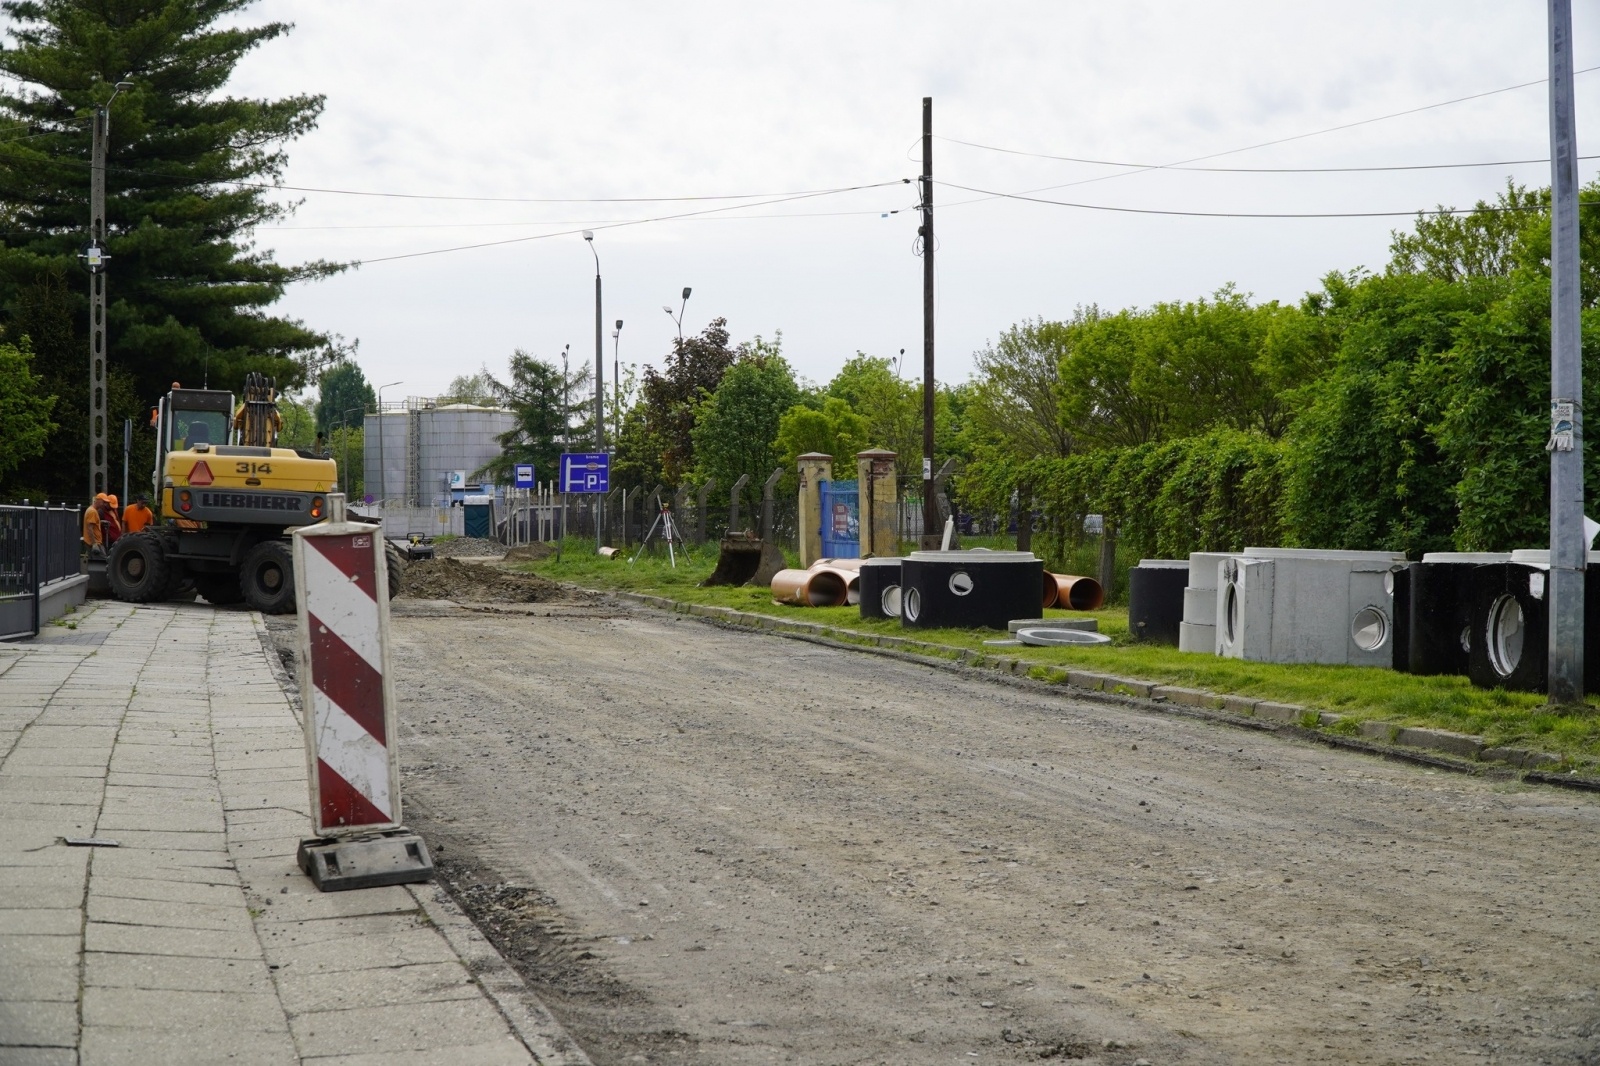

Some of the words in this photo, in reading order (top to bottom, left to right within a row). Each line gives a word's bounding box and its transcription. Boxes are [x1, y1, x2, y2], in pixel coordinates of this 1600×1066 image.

[236, 462, 272, 474] 314
[588, 475, 597, 488] P
[202, 493, 301, 510] LIEBHERR
